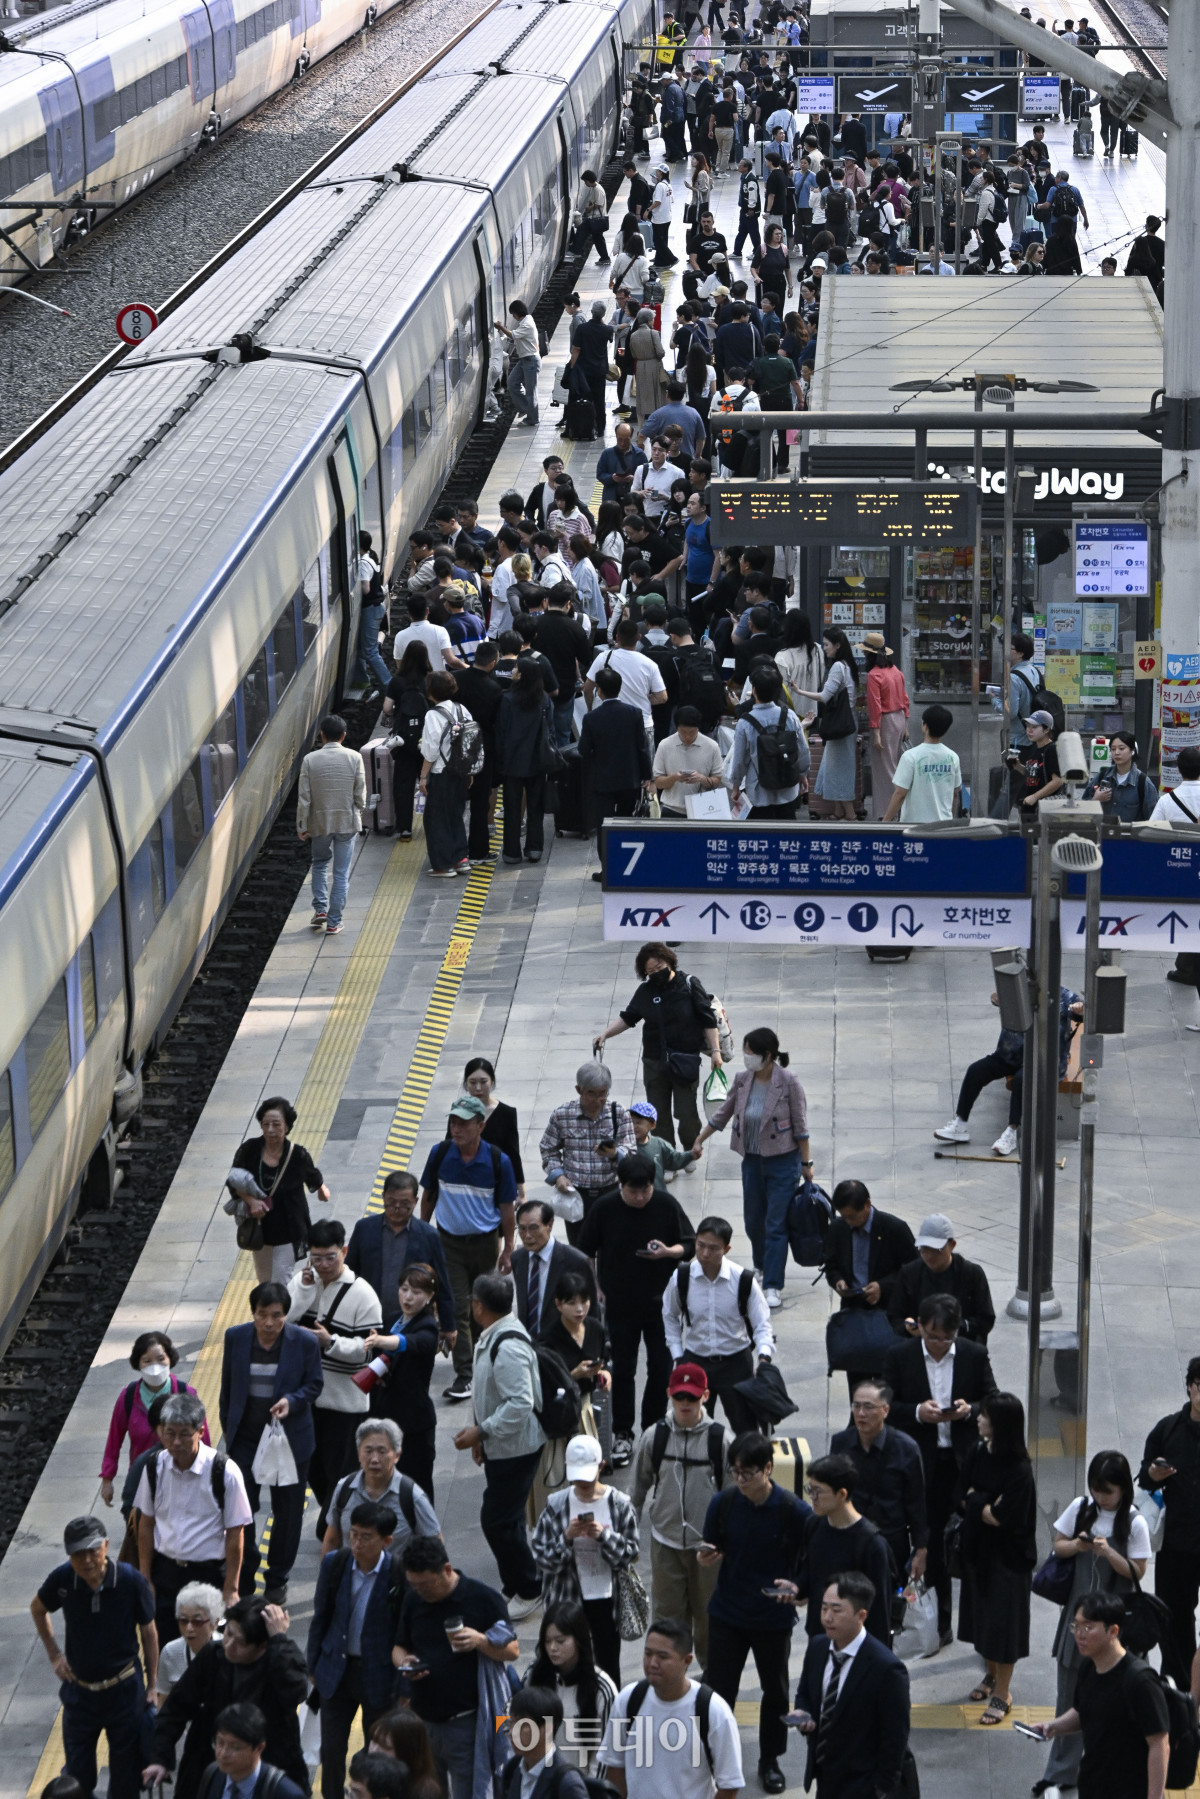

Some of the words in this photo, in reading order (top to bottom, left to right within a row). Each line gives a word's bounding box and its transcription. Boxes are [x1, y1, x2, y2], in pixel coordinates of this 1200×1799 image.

[885, 24, 944, 38] 고객대
[132, 310, 142, 324] 8
[132, 325, 142, 339] 6
[967, 466, 1124, 500] toyWay
[1080, 527, 1110, 537] 호차번호
[1077, 543, 1094, 551] KTX
[933, 641, 984, 652] StoryWy
[1184, 656, 1199, 667] AED
[1163, 691, 1183, 703] 전기
[707, 839, 728, 852] 대전
[737, 840, 769, 852] 동대구
[779, 840, 800, 853] 부산
[810, 841, 832, 853] 포항
[841, 841, 862, 854] 진주
[872, 842, 894, 854] 마산
[903, 842, 924, 855] 강릉
[1171, 847, 1192, 859] 대전
[621, 842, 645, 876] 7
[737, 853, 769, 861] Dongdaegu
[809, 854, 832, 862] Pohang
[707, 862, 728, 874] 익산
[737, 862, 779, 875] 광주송정
[789, 863, 810, 875] 목포
[820, 864, 870, 876] 여수EXPO
[875, 864, 896, 877] 방면
[1167, 860, 1191, 868] Daejeon
[789, 876, 809, 884] Mokpo
[620, 905, 687, 927] KTX
[741, 905, 770, 926] 18
[943, 907, 1012, 926] 호차번호
[943, 931, 956, 939] Car
[958, 931, 991, 940] number
